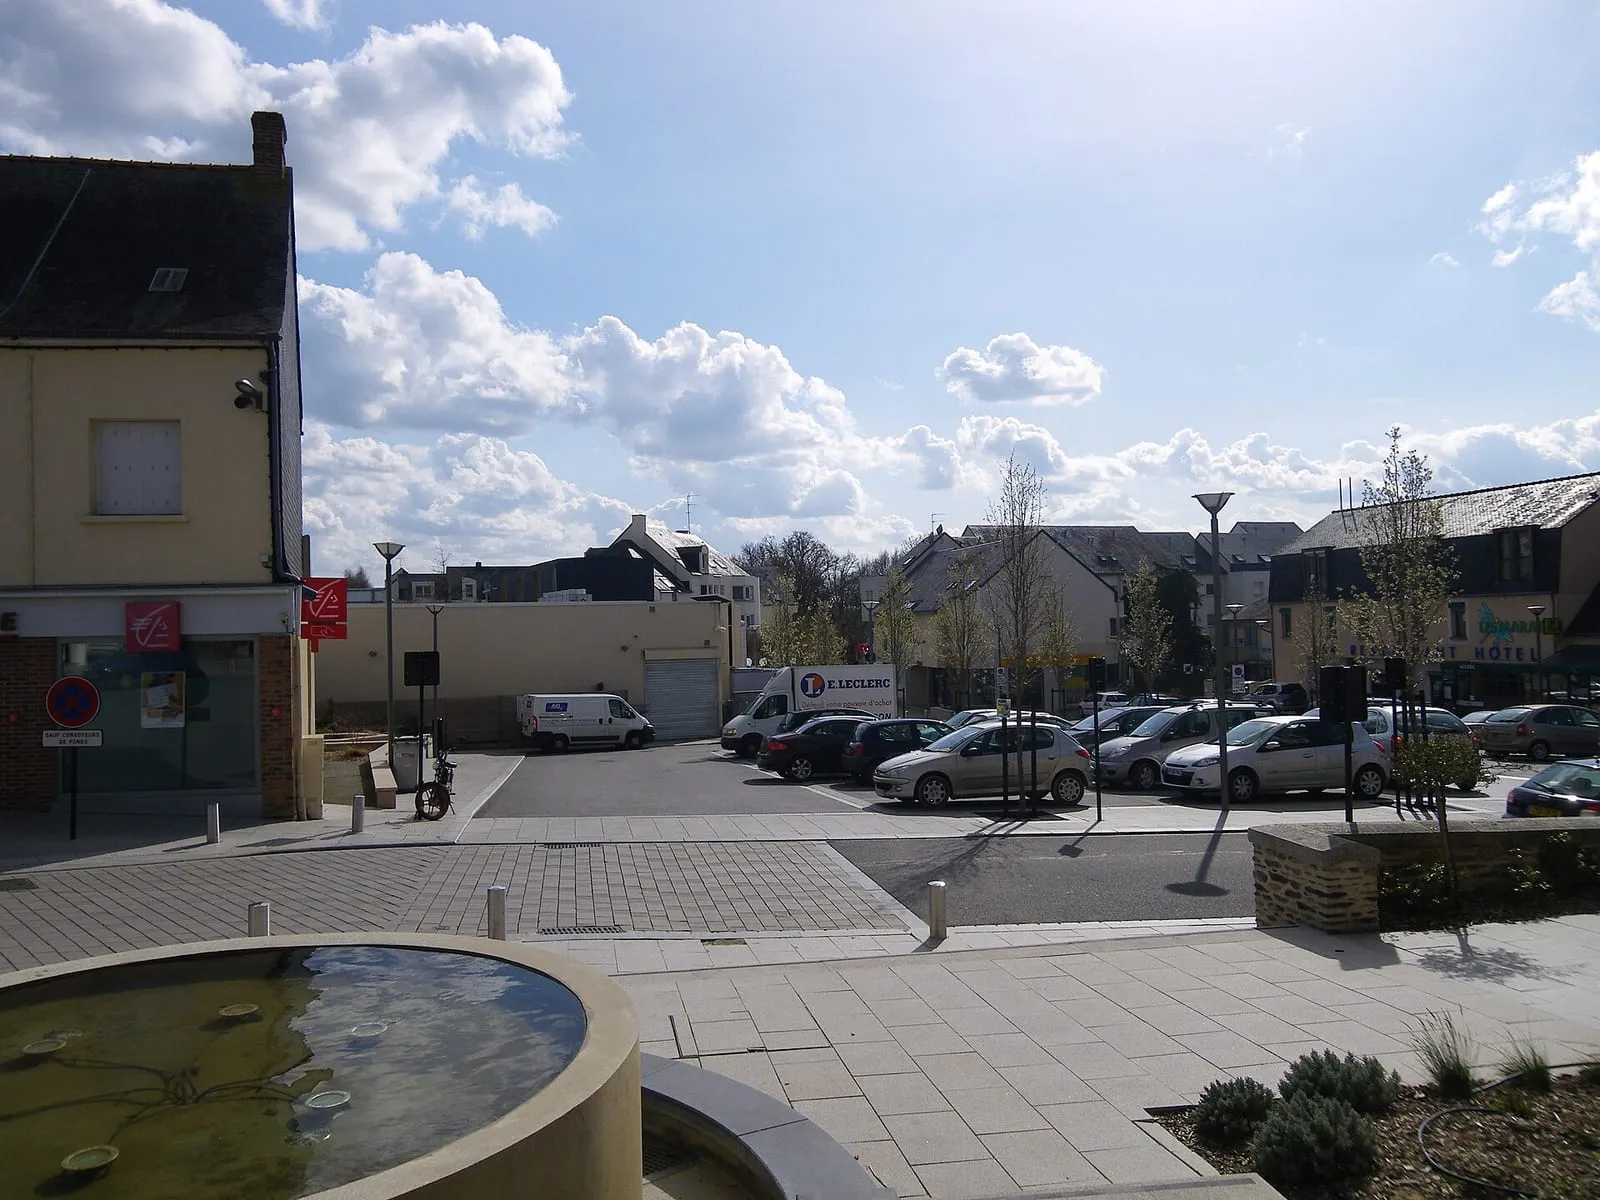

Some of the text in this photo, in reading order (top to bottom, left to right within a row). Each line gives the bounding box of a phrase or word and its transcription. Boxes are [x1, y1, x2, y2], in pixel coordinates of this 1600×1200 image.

[827, 679, 890, 689] E.LECLERC
[843, 701, 867, 709] pouvoir
[869, 698, 892, 706] d'achat
